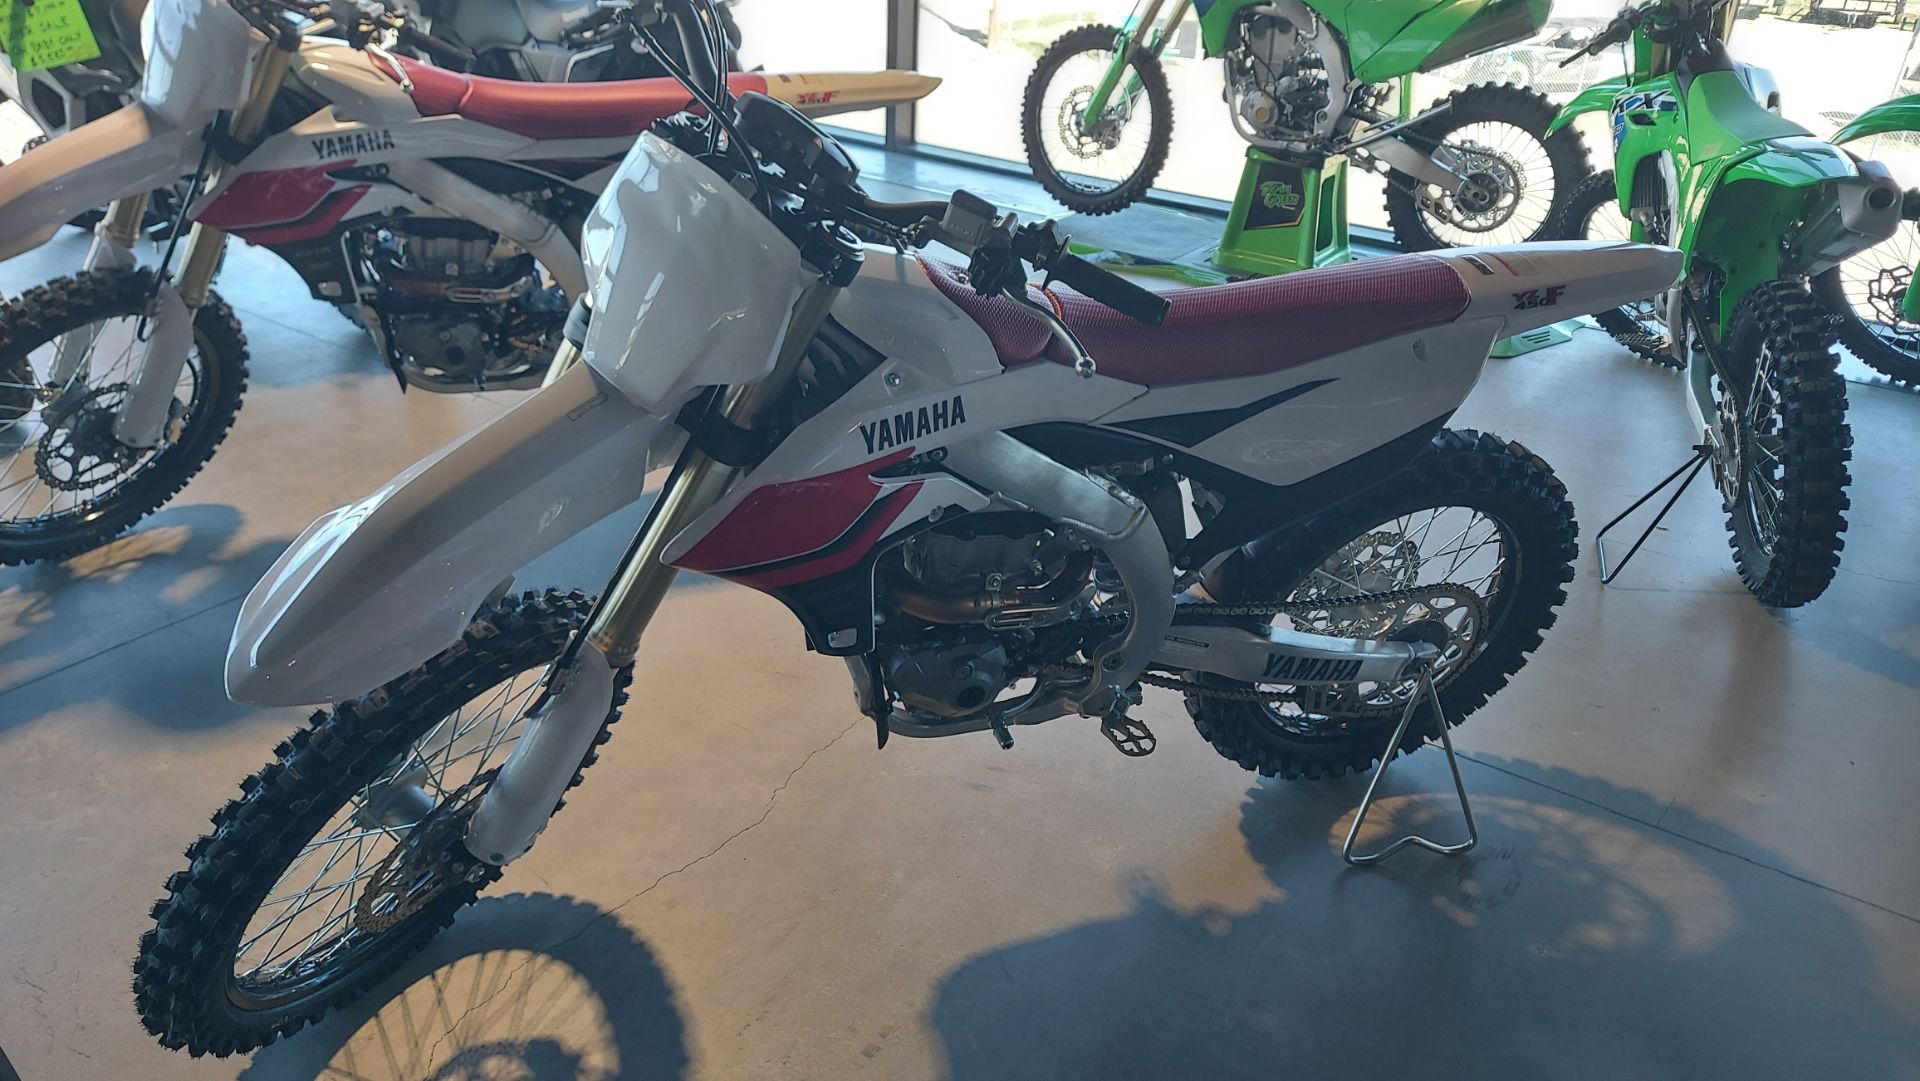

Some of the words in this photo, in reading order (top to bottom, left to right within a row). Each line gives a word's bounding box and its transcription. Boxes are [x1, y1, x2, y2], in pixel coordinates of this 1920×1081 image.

[312, 129, 395, 159] YAMAHA
[860, 395, 966, 454] YAMAHA
[1263, 652, 1364, 681] YAMAHA
